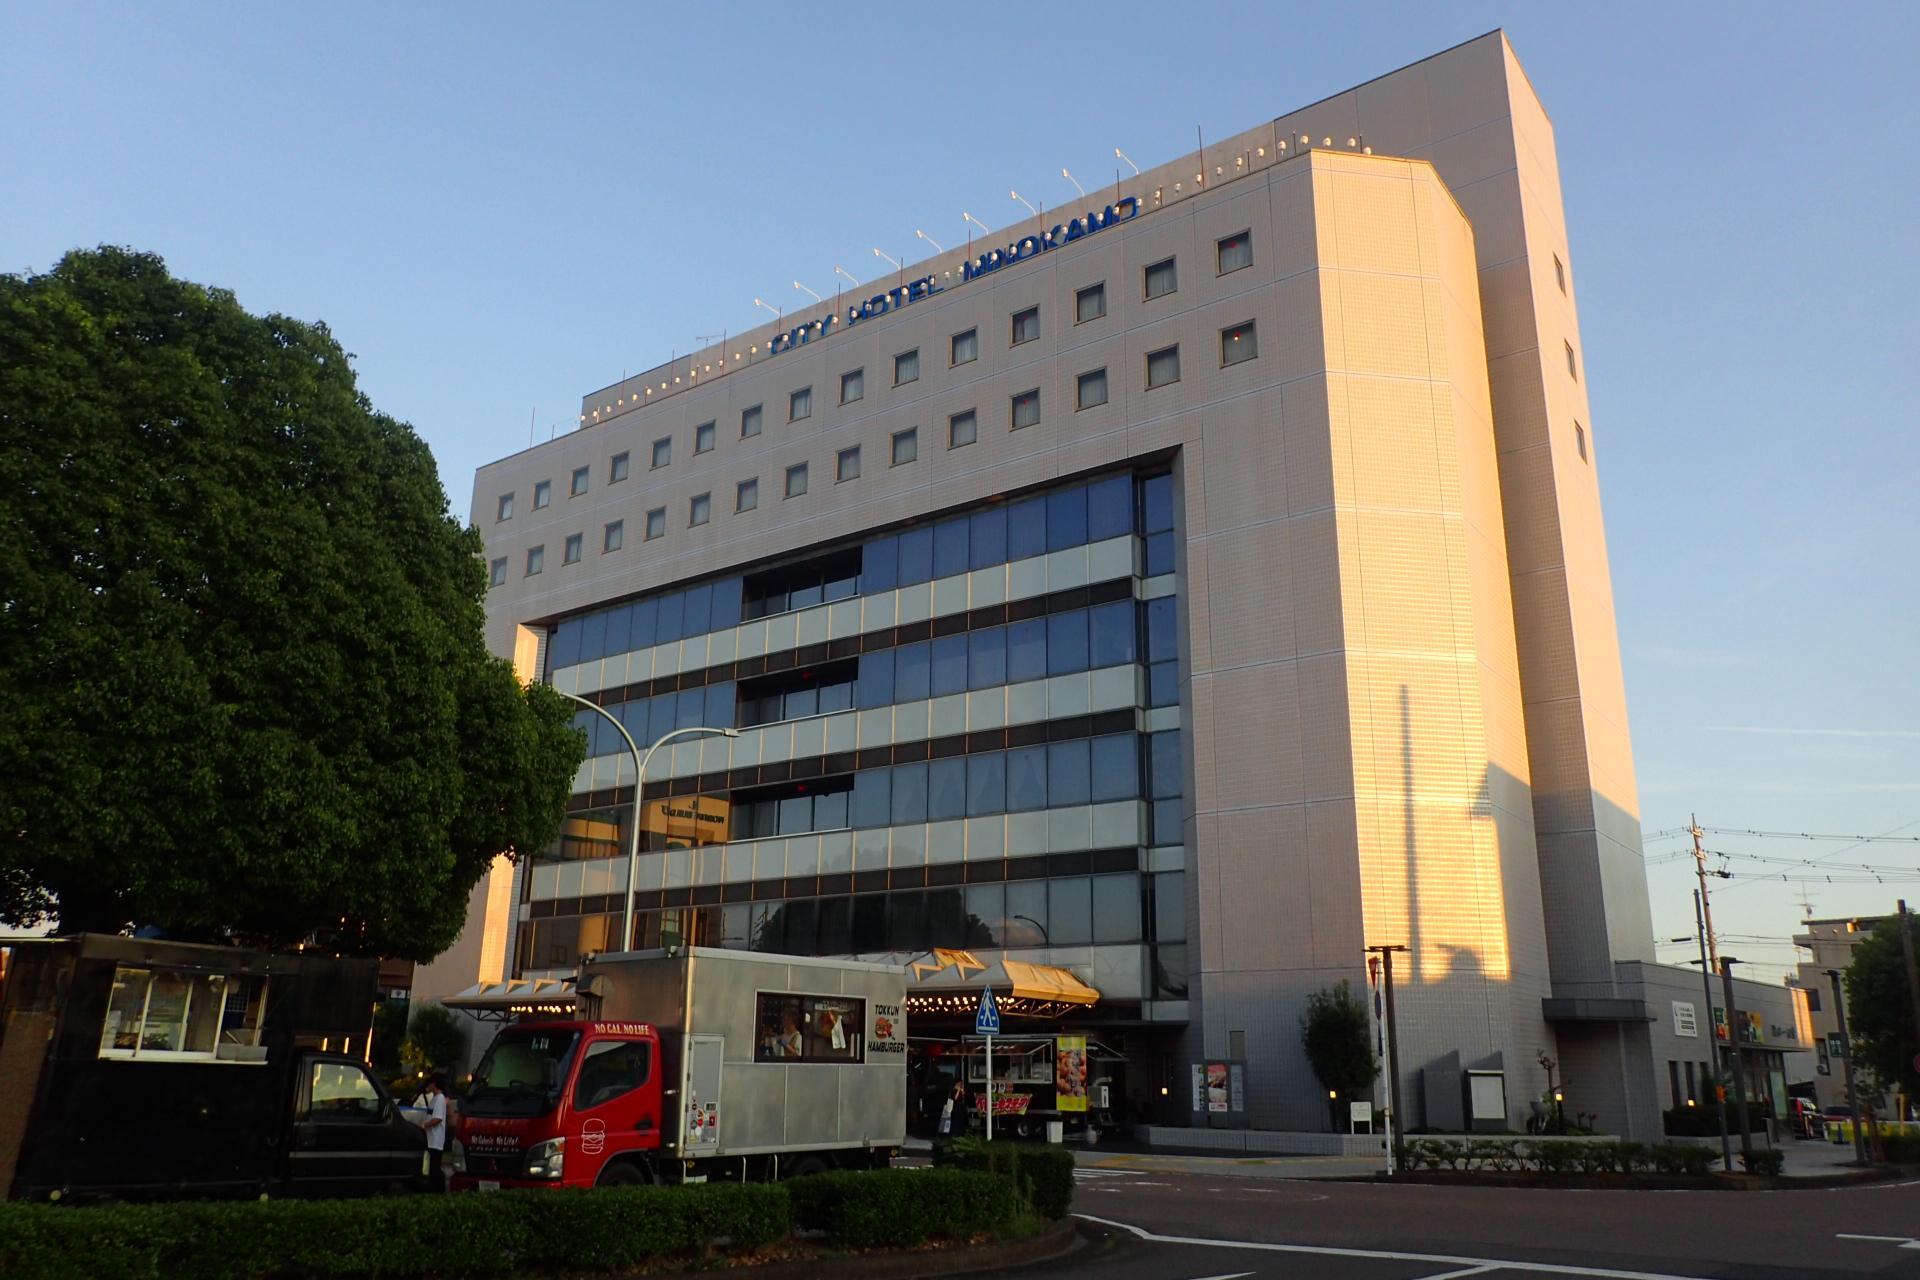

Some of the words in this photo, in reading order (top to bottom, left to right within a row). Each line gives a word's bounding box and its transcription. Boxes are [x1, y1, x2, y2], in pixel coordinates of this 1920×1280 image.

[770, 313, 835, 355] CITY
[848, 274, 945, 326] HOTEL
[963, 196, 1139, 281] MINOKAMO
[875, 1004, 900, 1016] TOKKUN
[595, 1023, 606, 1034] NO
[607, 1023, 622, 1035] CAL
[623, 1024, 634, 1035] NO
[634, 1024, 650, 1036] LIFE
[868, 1041, 905, 1054] HAMBURGER
